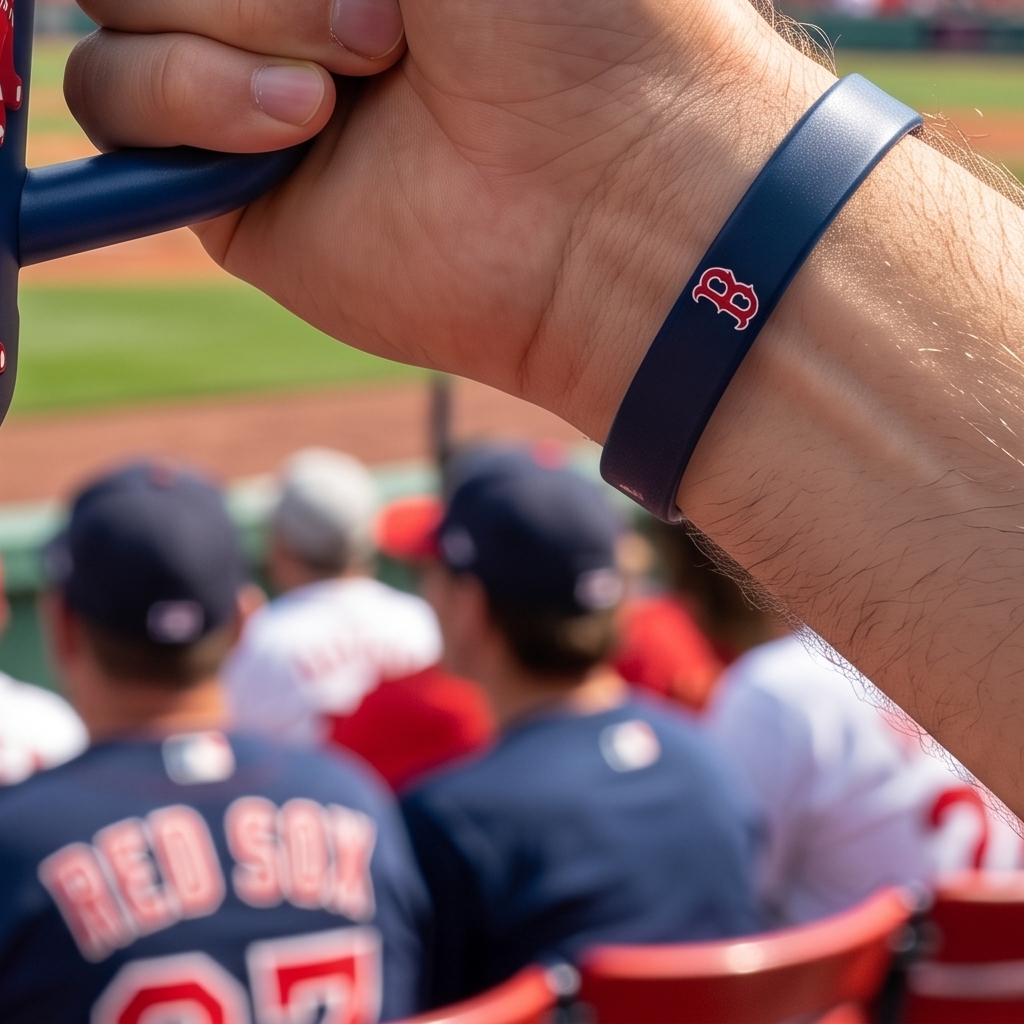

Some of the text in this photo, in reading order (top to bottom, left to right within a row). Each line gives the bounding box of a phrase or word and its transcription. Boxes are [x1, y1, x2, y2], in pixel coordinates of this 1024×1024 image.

[691, 266, 759, 330] B
[38, 795, 377, 964] RED SOX
